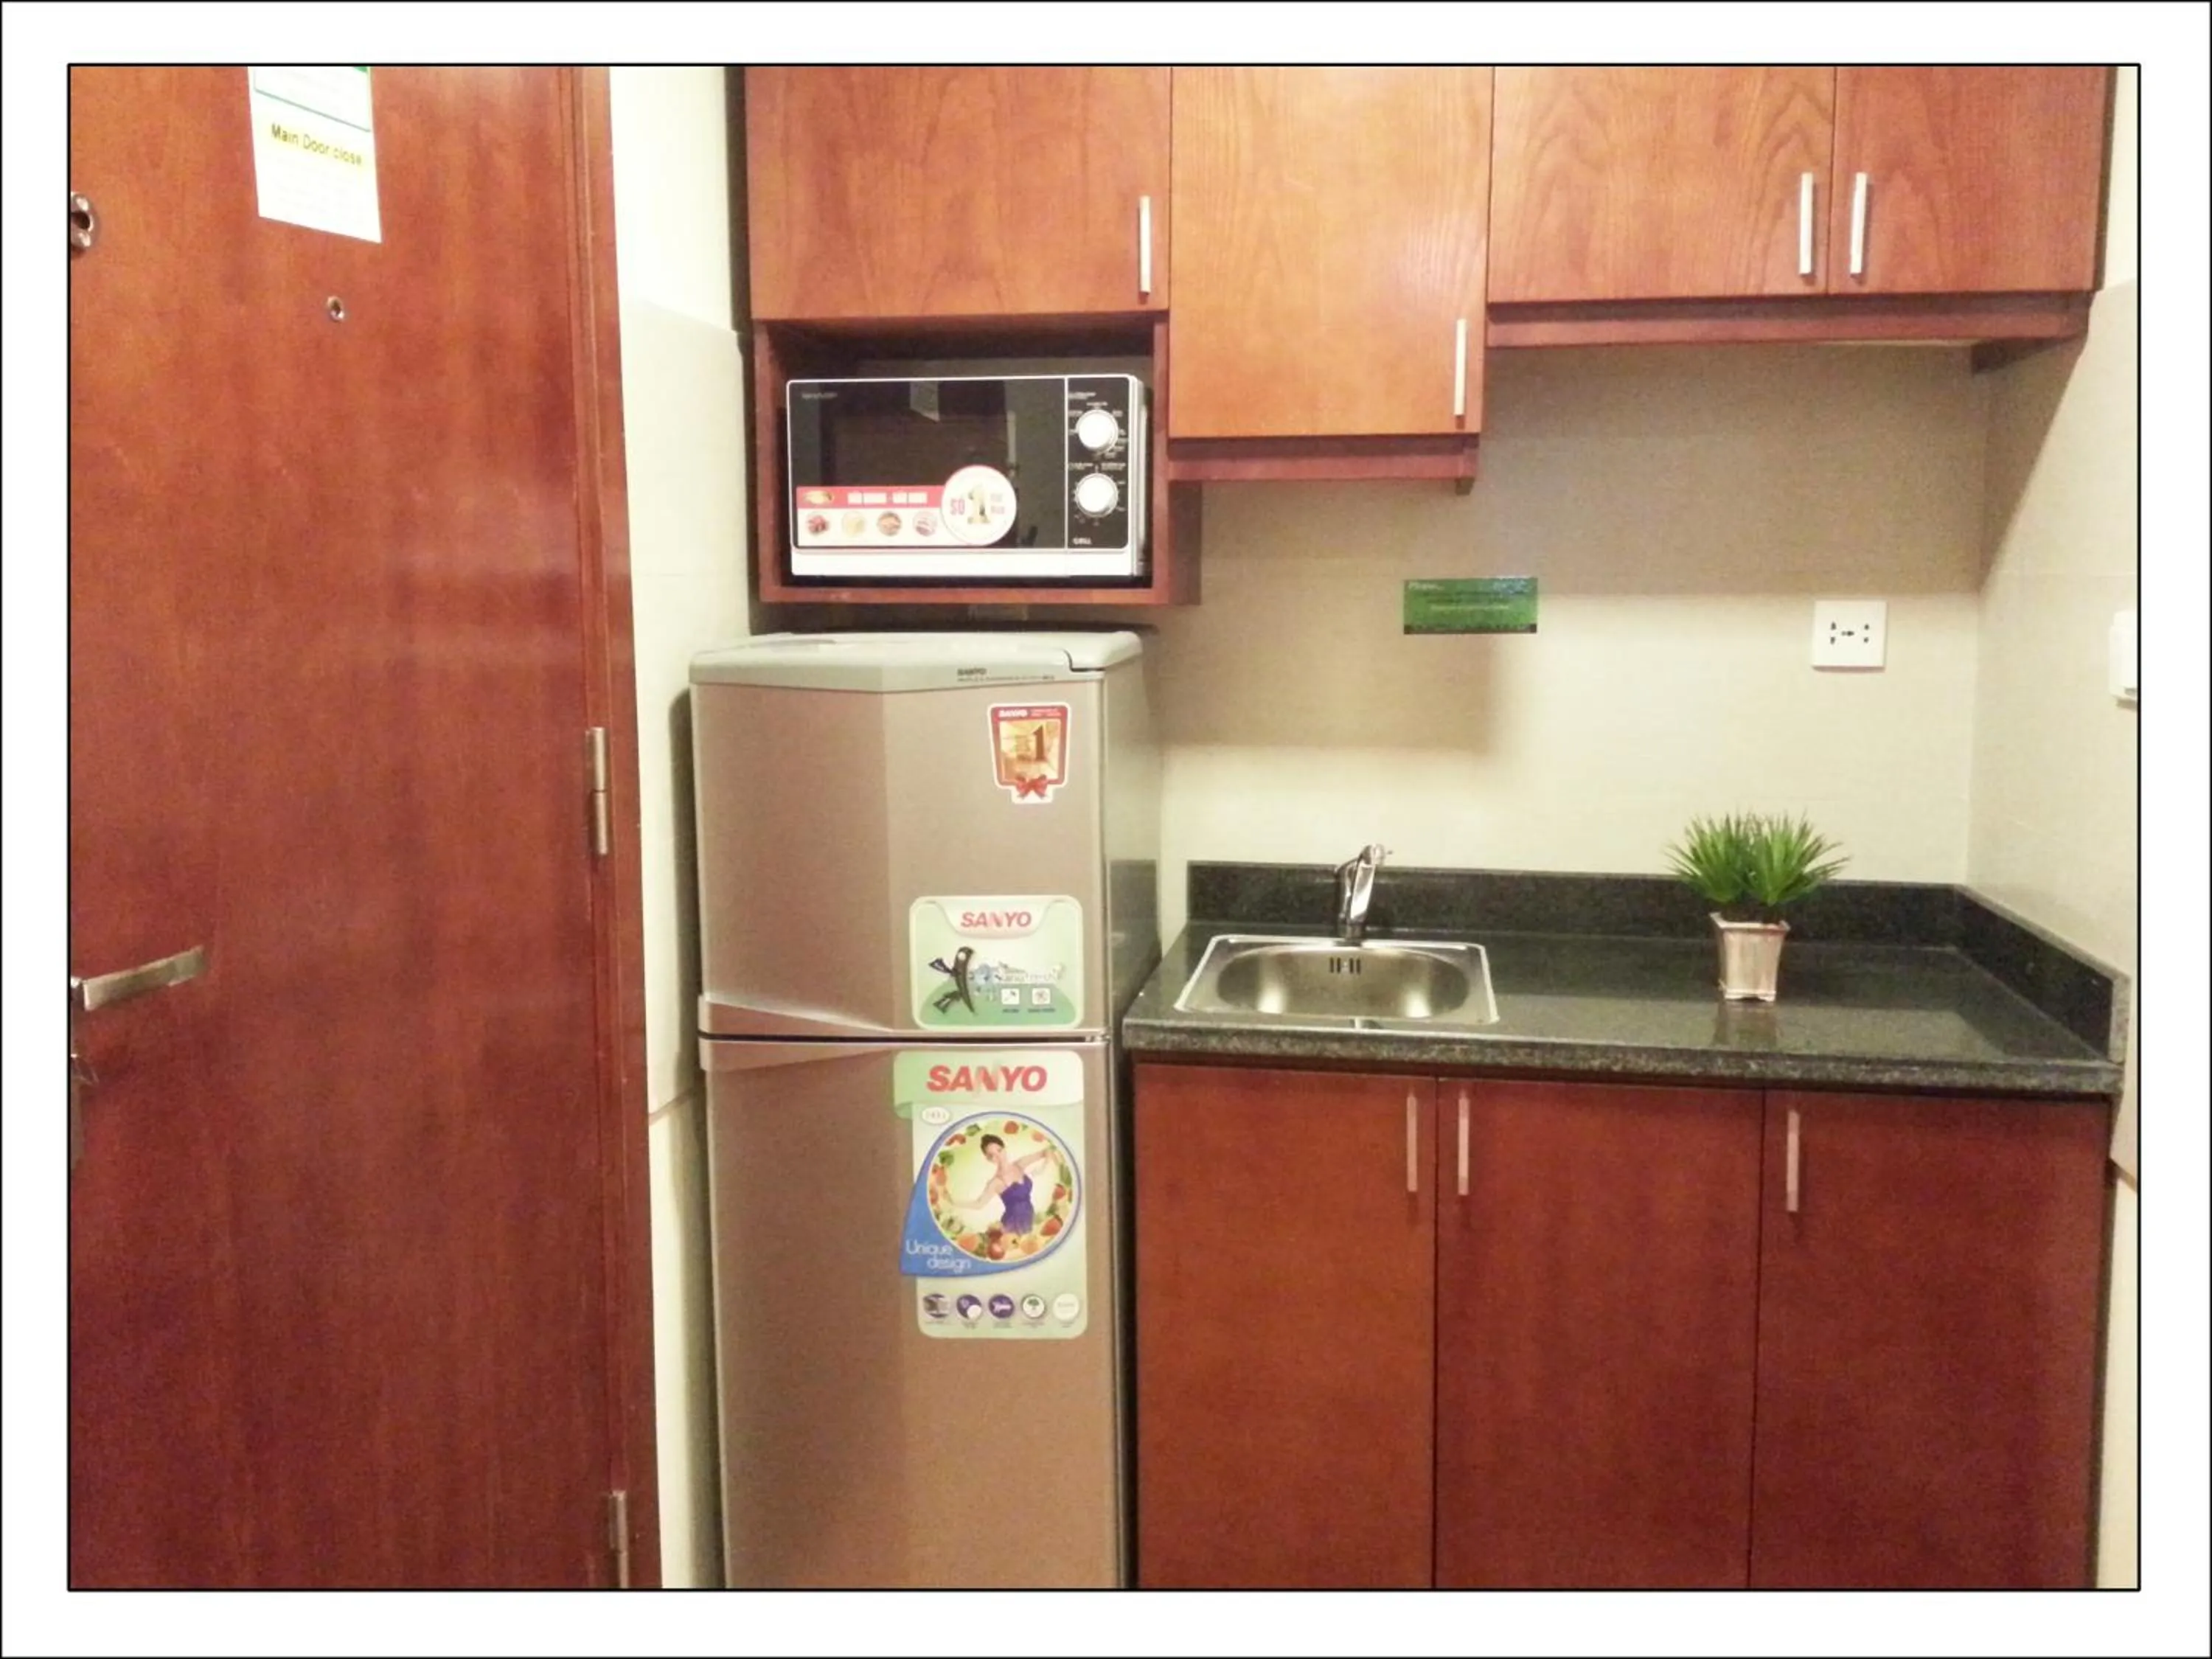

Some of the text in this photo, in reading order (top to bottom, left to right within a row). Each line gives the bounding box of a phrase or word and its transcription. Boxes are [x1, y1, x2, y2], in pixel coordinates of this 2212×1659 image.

[271, 122, 362, 165] Main Door close
[961, 911, 1032, 928] SANYO
[926, 1065, 1048, 1093] SANYO
[905, 1238, 954, 1258] Unique
[926, 1254, 972, 1275] design
